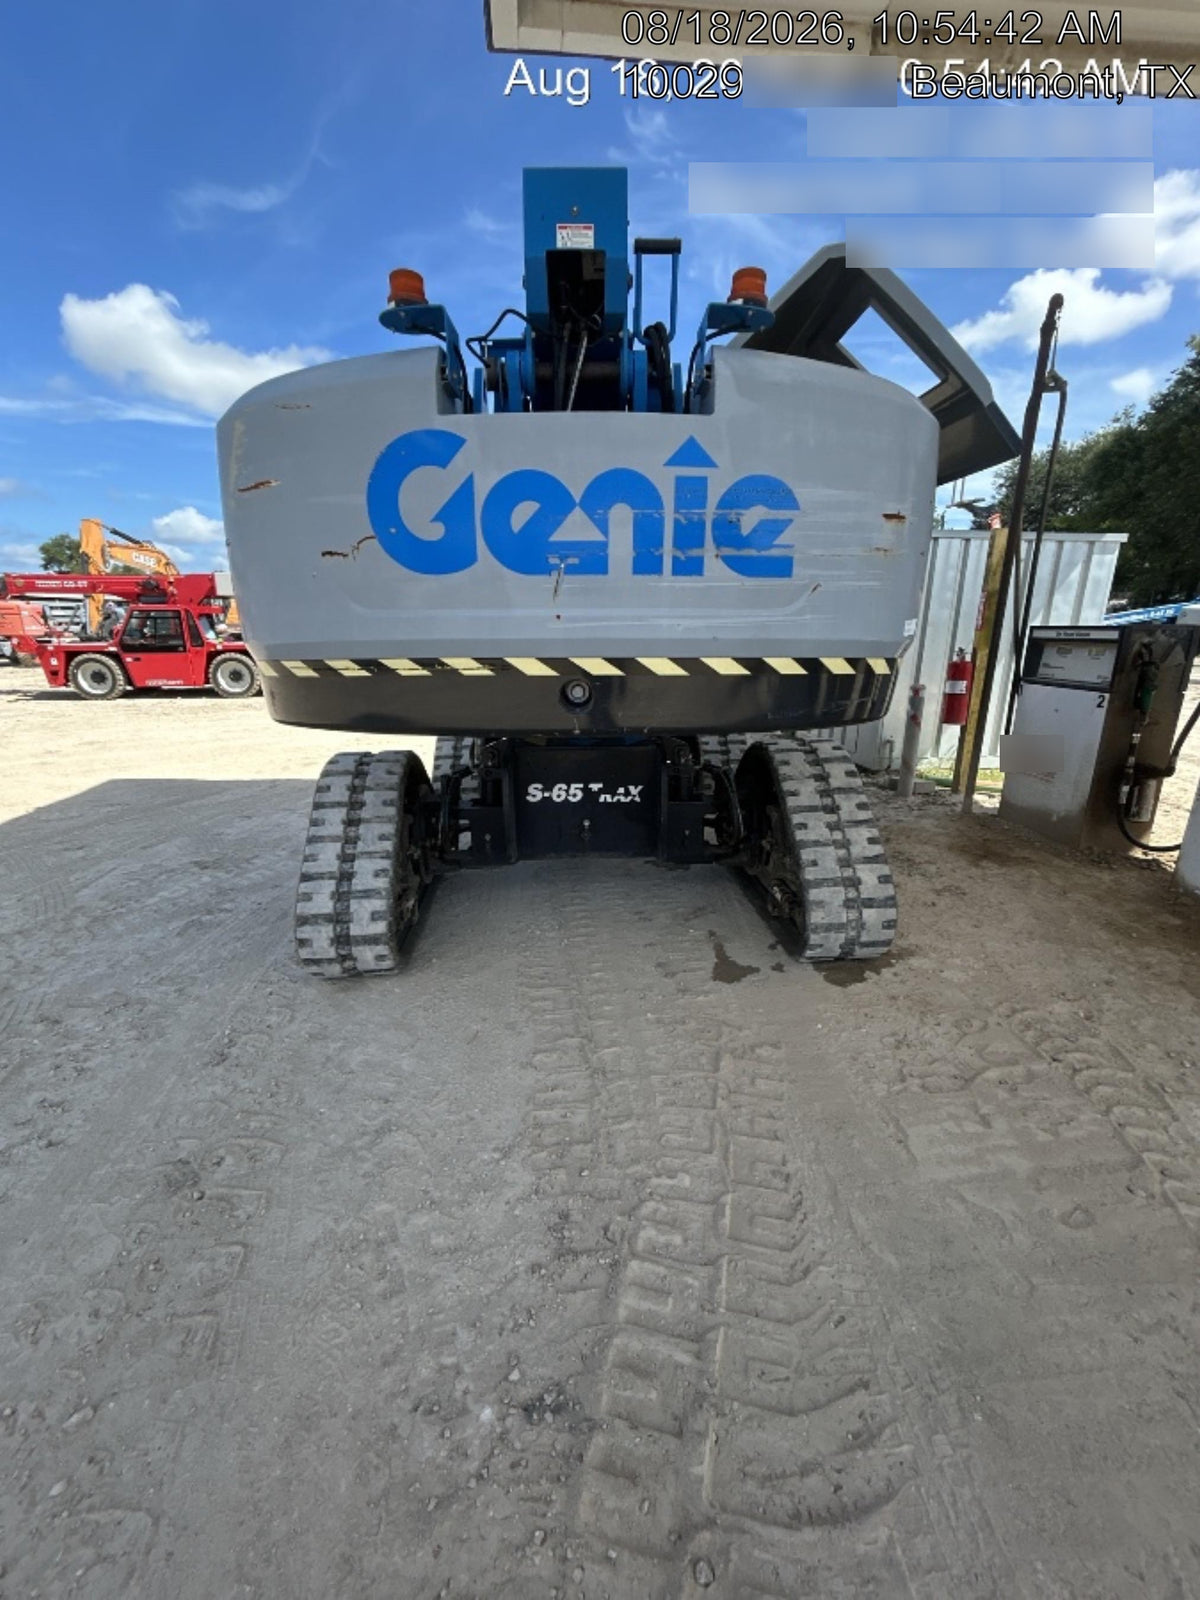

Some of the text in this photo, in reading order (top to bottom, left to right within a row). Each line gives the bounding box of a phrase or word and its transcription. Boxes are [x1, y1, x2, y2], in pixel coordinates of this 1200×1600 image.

[366, 428, 800, 578] Genie
[1096, 694, 1106, 708] 2
[525, 783, 584, 802] S-65
